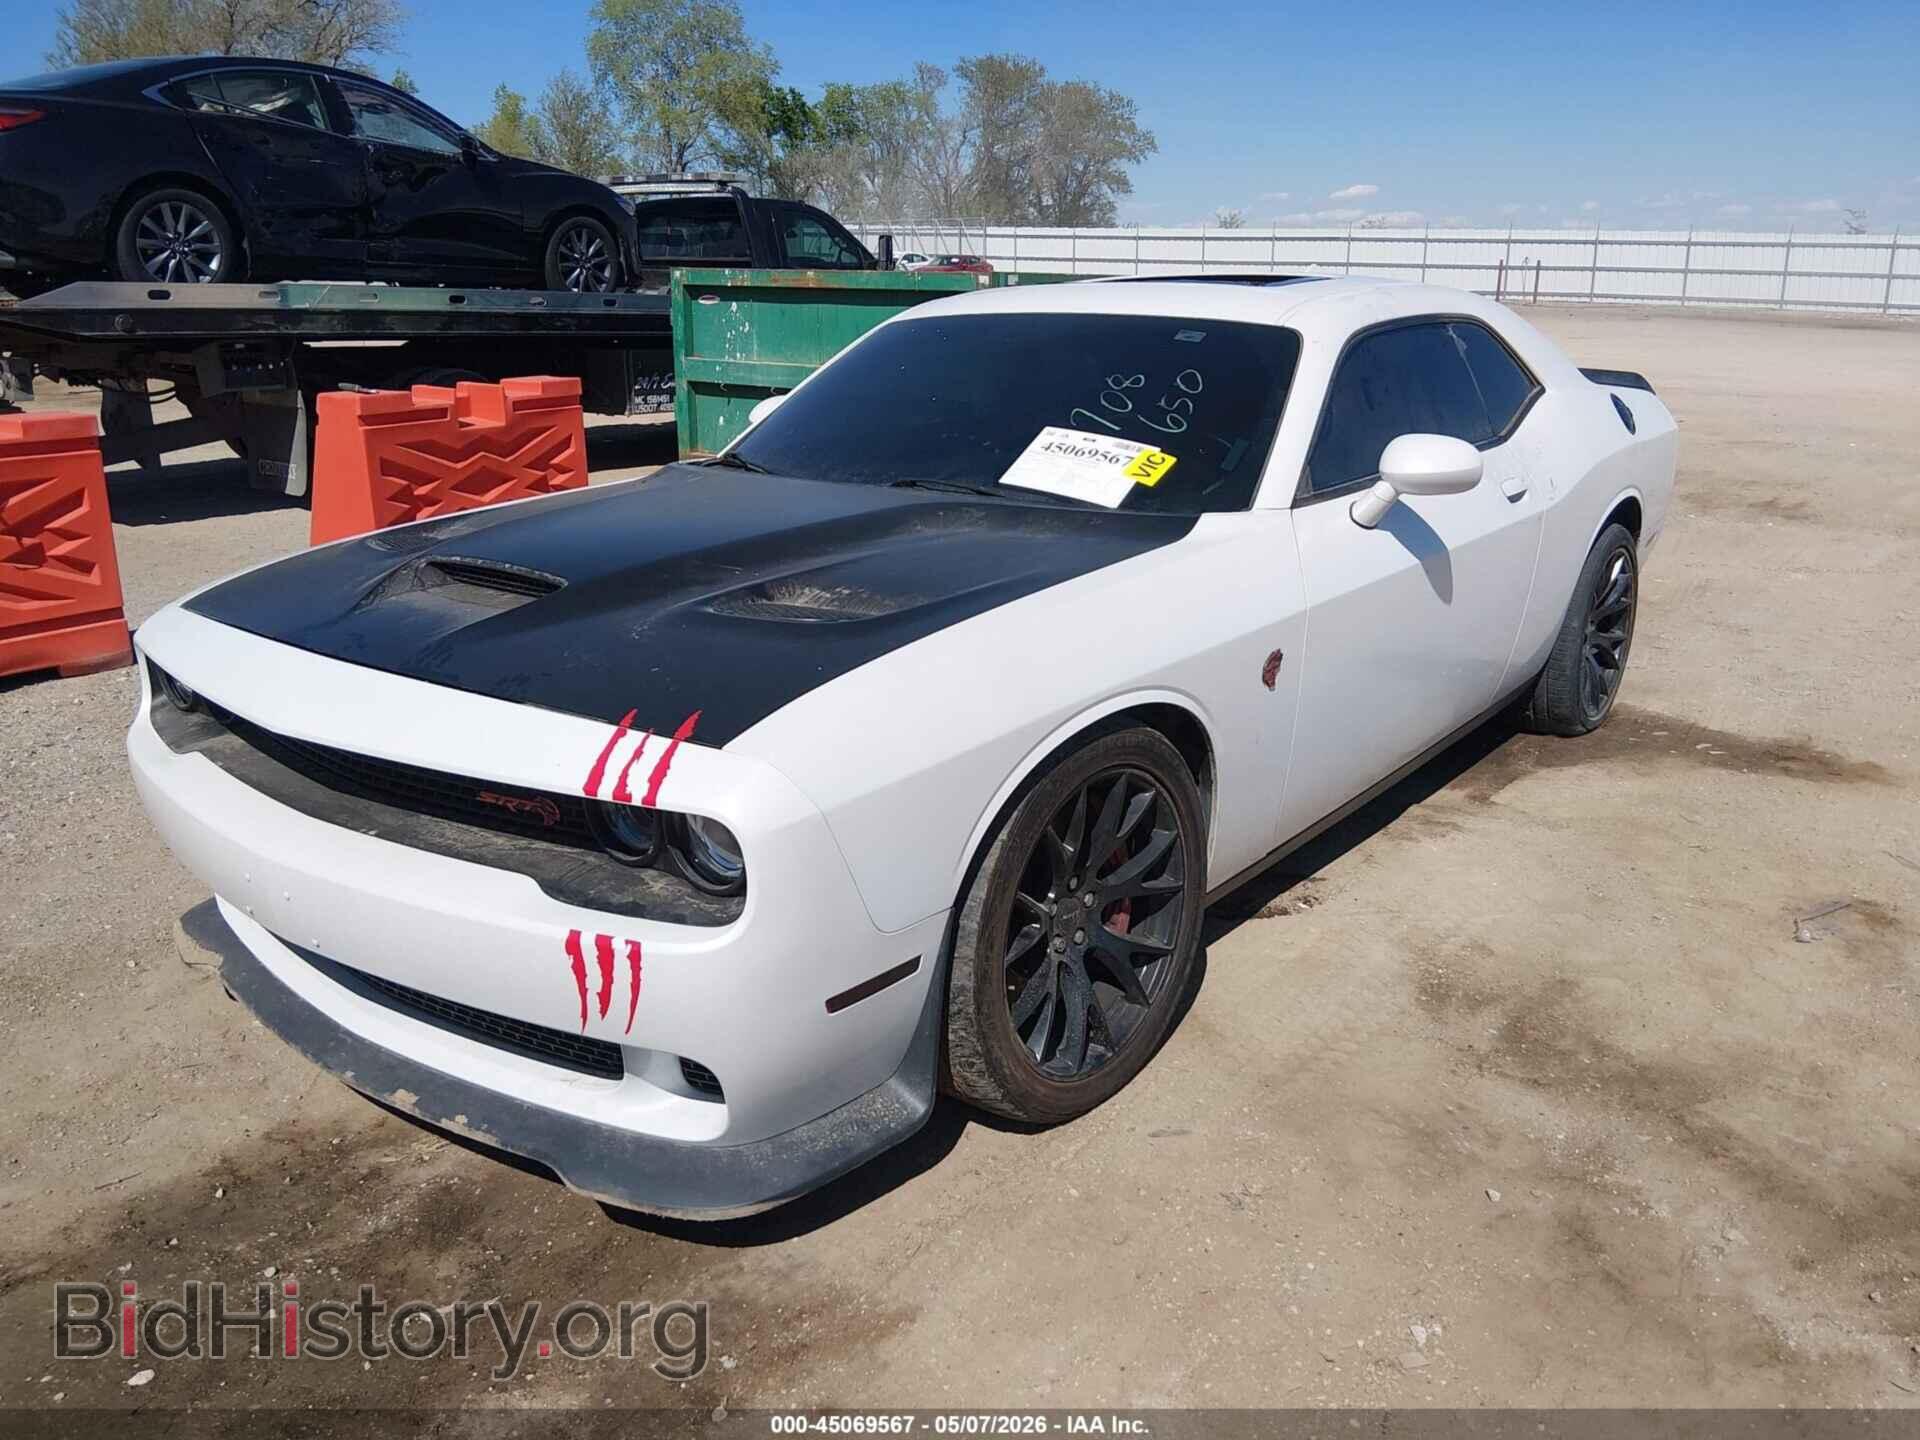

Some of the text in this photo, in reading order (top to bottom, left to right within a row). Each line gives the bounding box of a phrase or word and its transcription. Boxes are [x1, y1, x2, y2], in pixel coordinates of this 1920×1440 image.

[635, 404, 658, 413] USDOT
[1137, 369, 1203, 433] 650
[1040, 441, 1136, 468] 45069567
[1132, 453, 1166, 479] VIC
